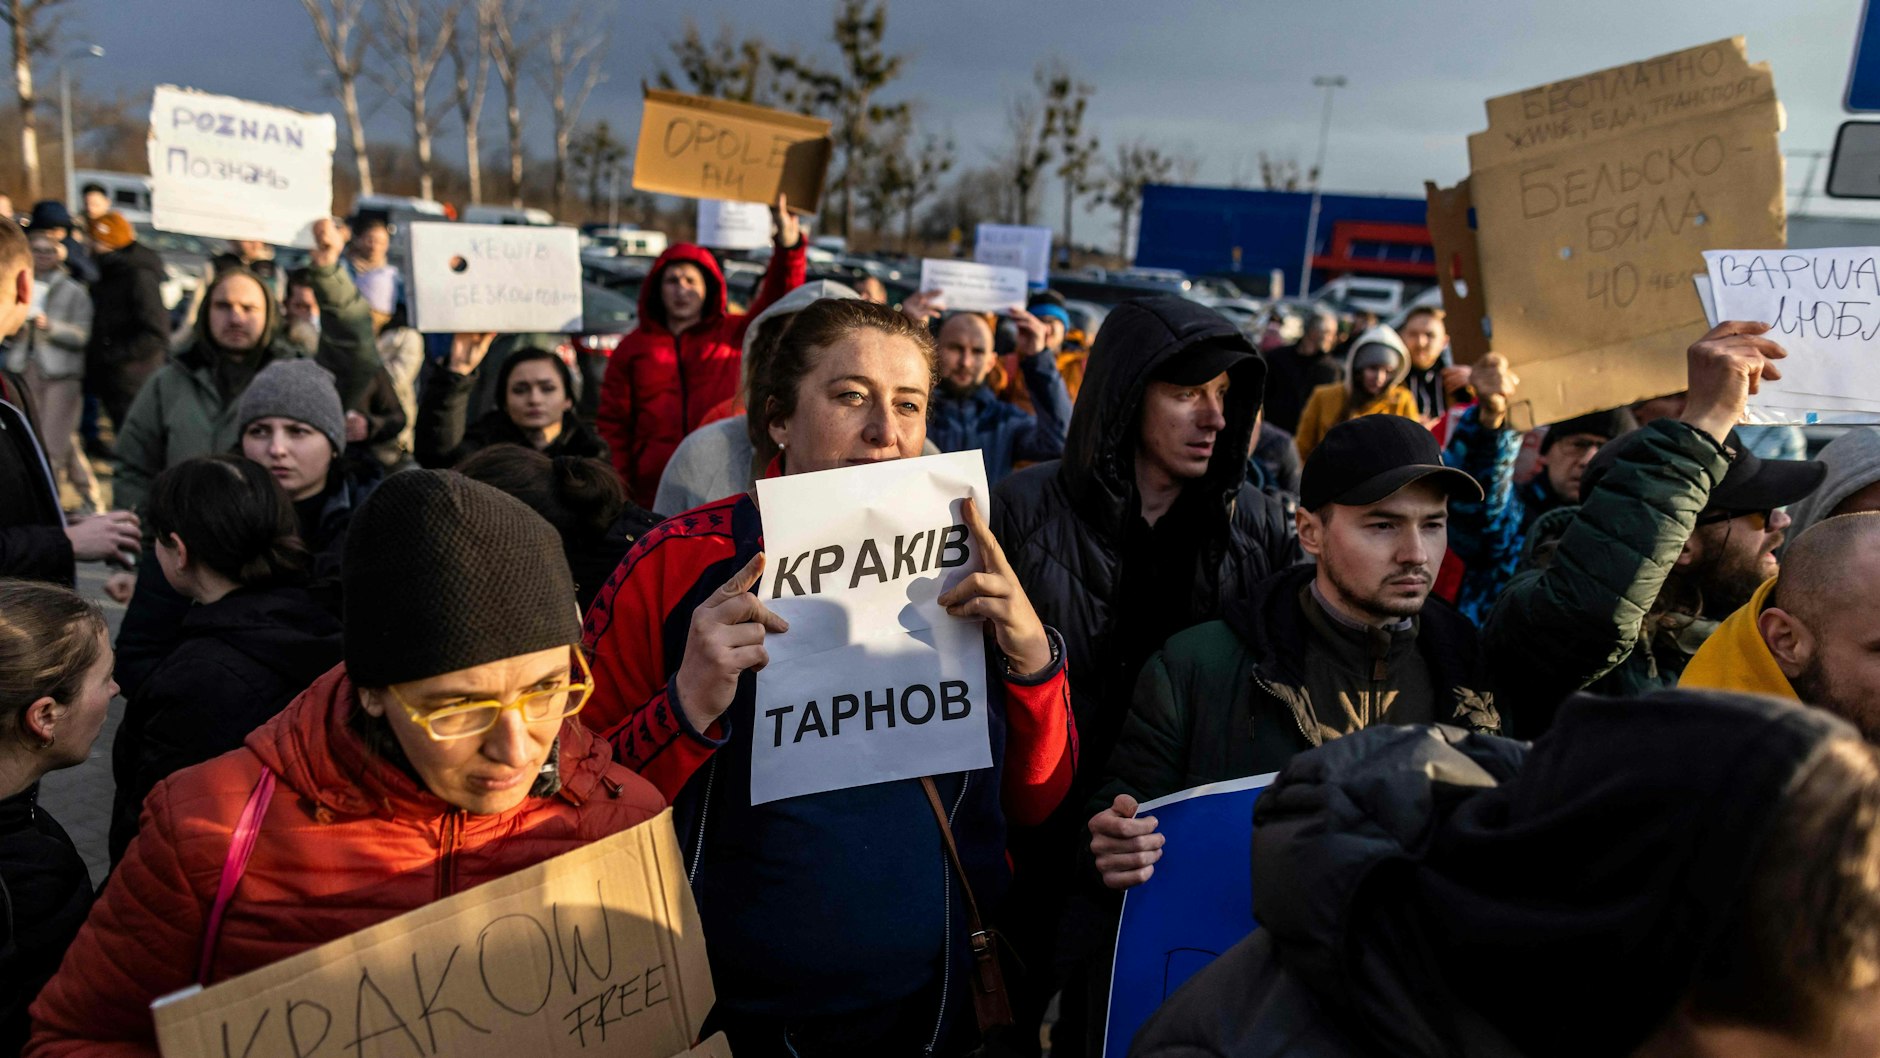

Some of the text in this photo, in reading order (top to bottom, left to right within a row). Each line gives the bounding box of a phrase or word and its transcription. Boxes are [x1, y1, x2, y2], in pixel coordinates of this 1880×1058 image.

[1520, 48, 1724, 120] БЕСПЛАТНО
[1649, 76, 1760, 116] ТРАНСПОРТ
[172, 107, 304, 148] POZNAŃ
[664, 117, 794, 168] OPOLE
[1586, 191, 1702, 252] БЯЛА
[1587, 261, 1639, 309] 40
[772, 524, 970, 599] КРАКІВ
[765, 680, 971, 747] ТАРНОВ
[563, 964, 669, 1048] FREE
